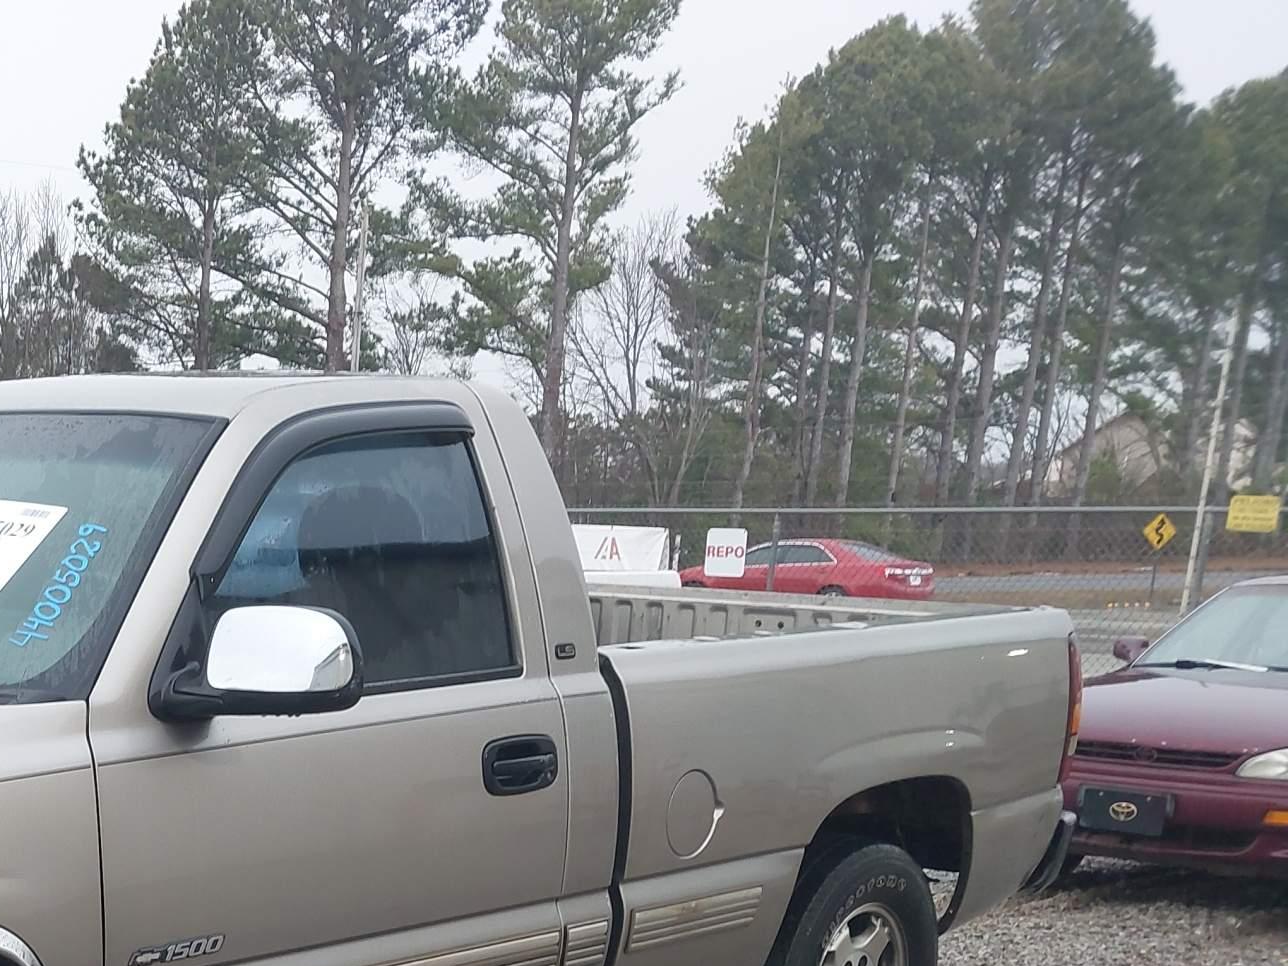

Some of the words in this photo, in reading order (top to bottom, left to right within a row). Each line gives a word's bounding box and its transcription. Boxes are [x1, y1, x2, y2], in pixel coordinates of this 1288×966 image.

[707, 545, 745, 558] REPO
[8, 521, 108, 649] 44005029
[557, 645, 575, 658] LS
[165, 935, 225, 962] 1500
